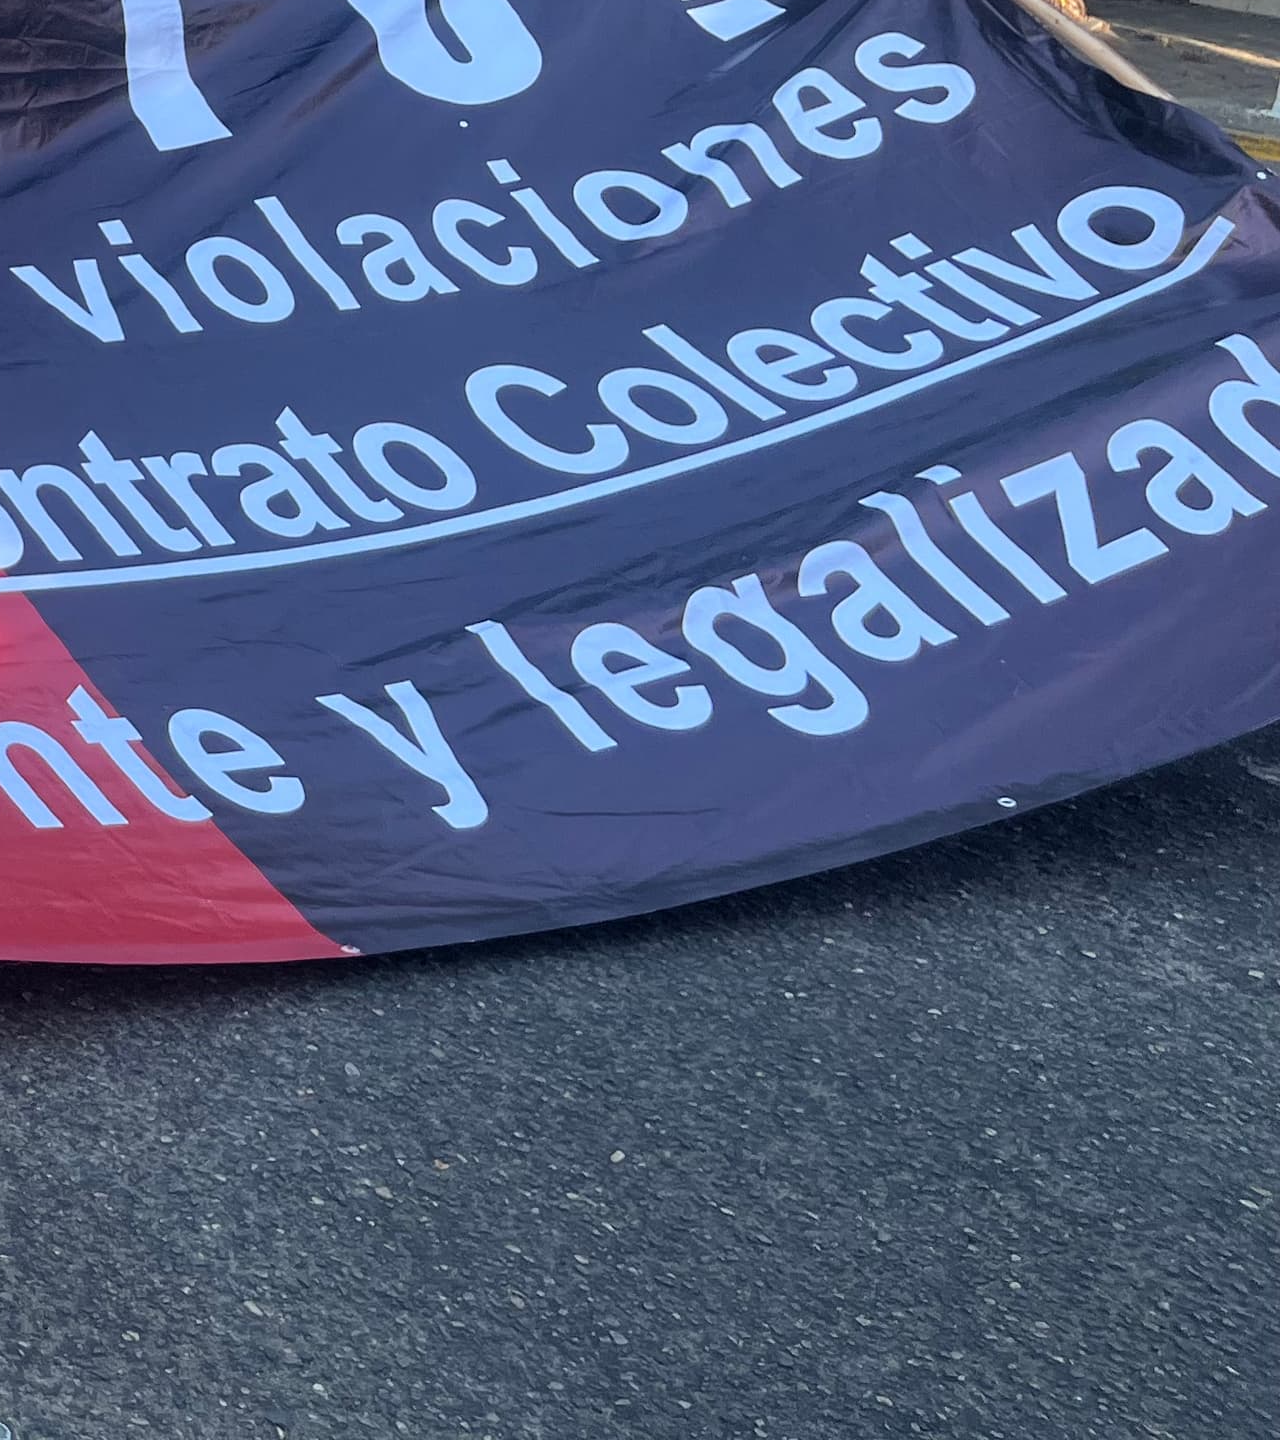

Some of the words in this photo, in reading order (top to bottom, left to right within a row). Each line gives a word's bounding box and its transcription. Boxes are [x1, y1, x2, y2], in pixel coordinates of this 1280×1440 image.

[8, 31, 978, 344] violaciones
[462, 184, 1187, 478] Colectivo
[314, 679, 490, 831] y
